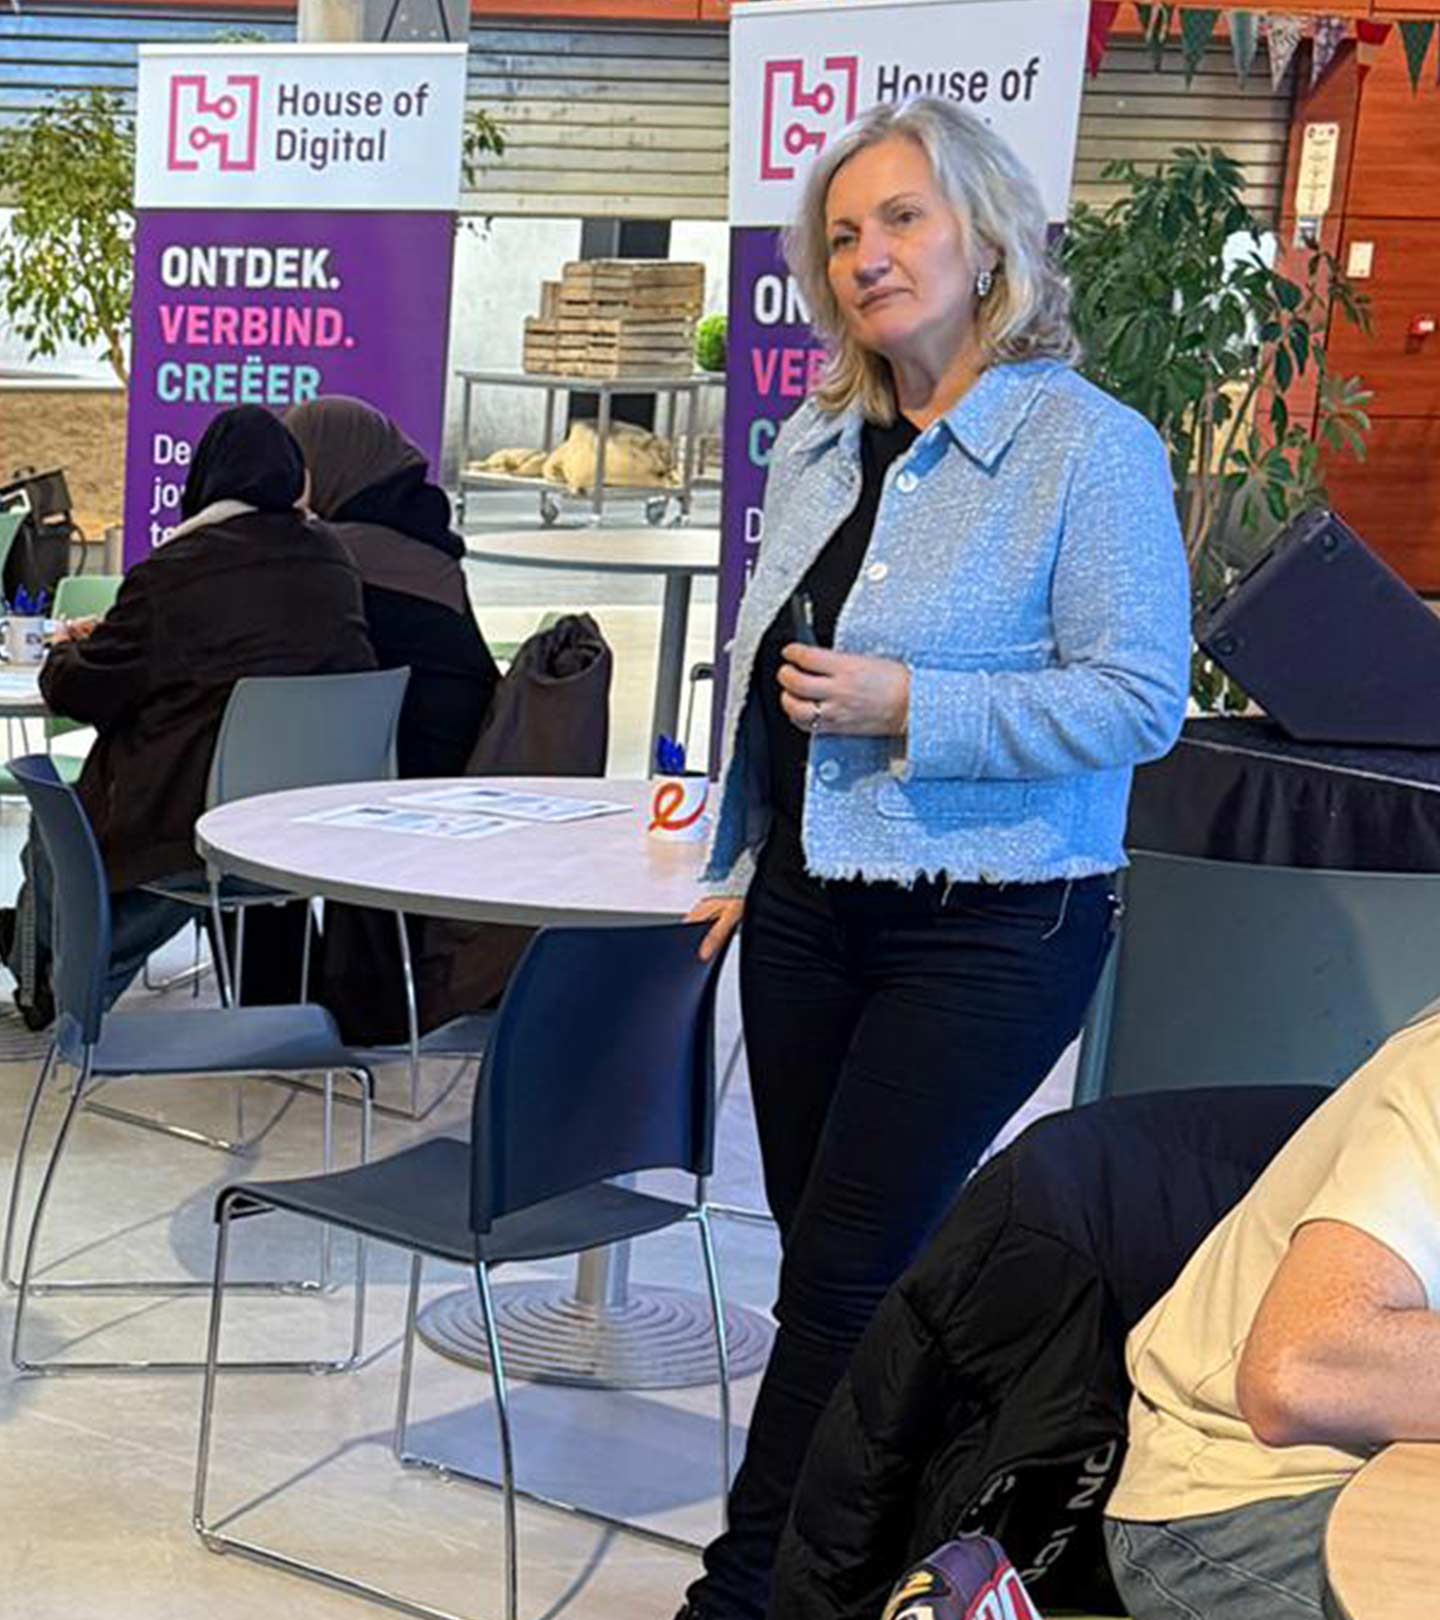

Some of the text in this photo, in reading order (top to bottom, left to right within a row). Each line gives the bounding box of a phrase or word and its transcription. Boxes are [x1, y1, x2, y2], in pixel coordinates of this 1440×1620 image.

[277, 83, 430, 117] House of
[877, 56, 1040, 104] House of
[275, 129, 387, 171] Digital
[161, 246, 341, 290] ONTDEK.
[160, 305, 356, 348] VERBIND.
[154, 433, 192, 466] De
[149, 476, 186, 515] jo
